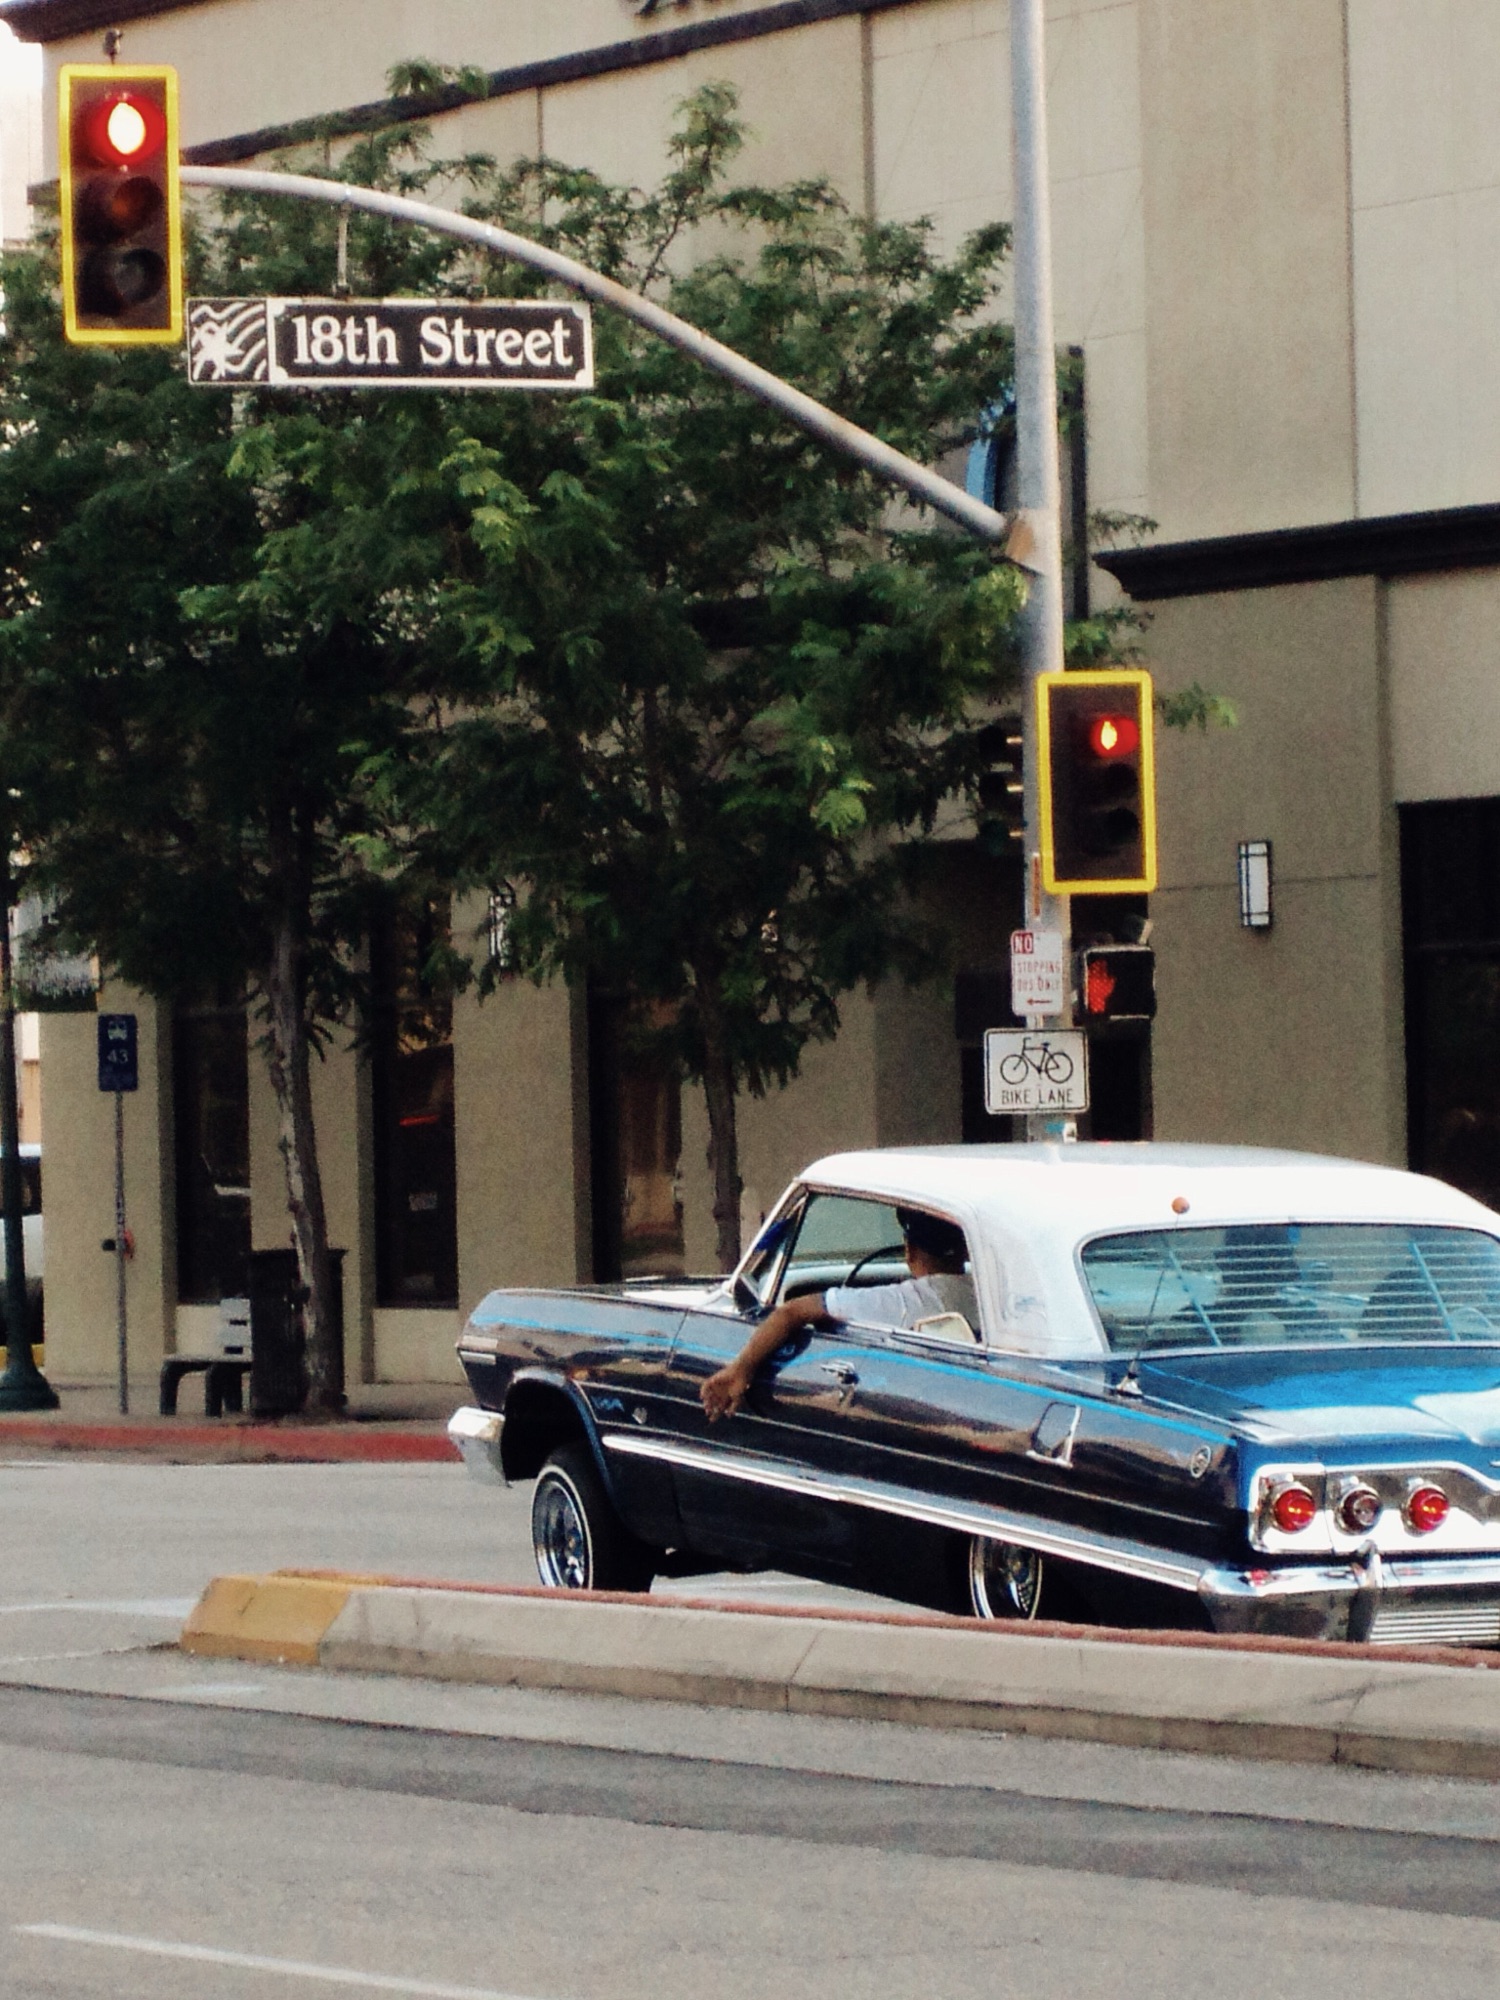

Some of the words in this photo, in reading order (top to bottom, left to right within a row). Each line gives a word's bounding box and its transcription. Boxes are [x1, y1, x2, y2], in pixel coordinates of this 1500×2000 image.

[292, 314, 399, 365] 18th
[419, 315, 573, 367] Street
[1014, 933, 1034, 952] NO
[1002, 1089, 1030, 1105] BIKE
[1038, 1088, 1073, 1105] LANE
